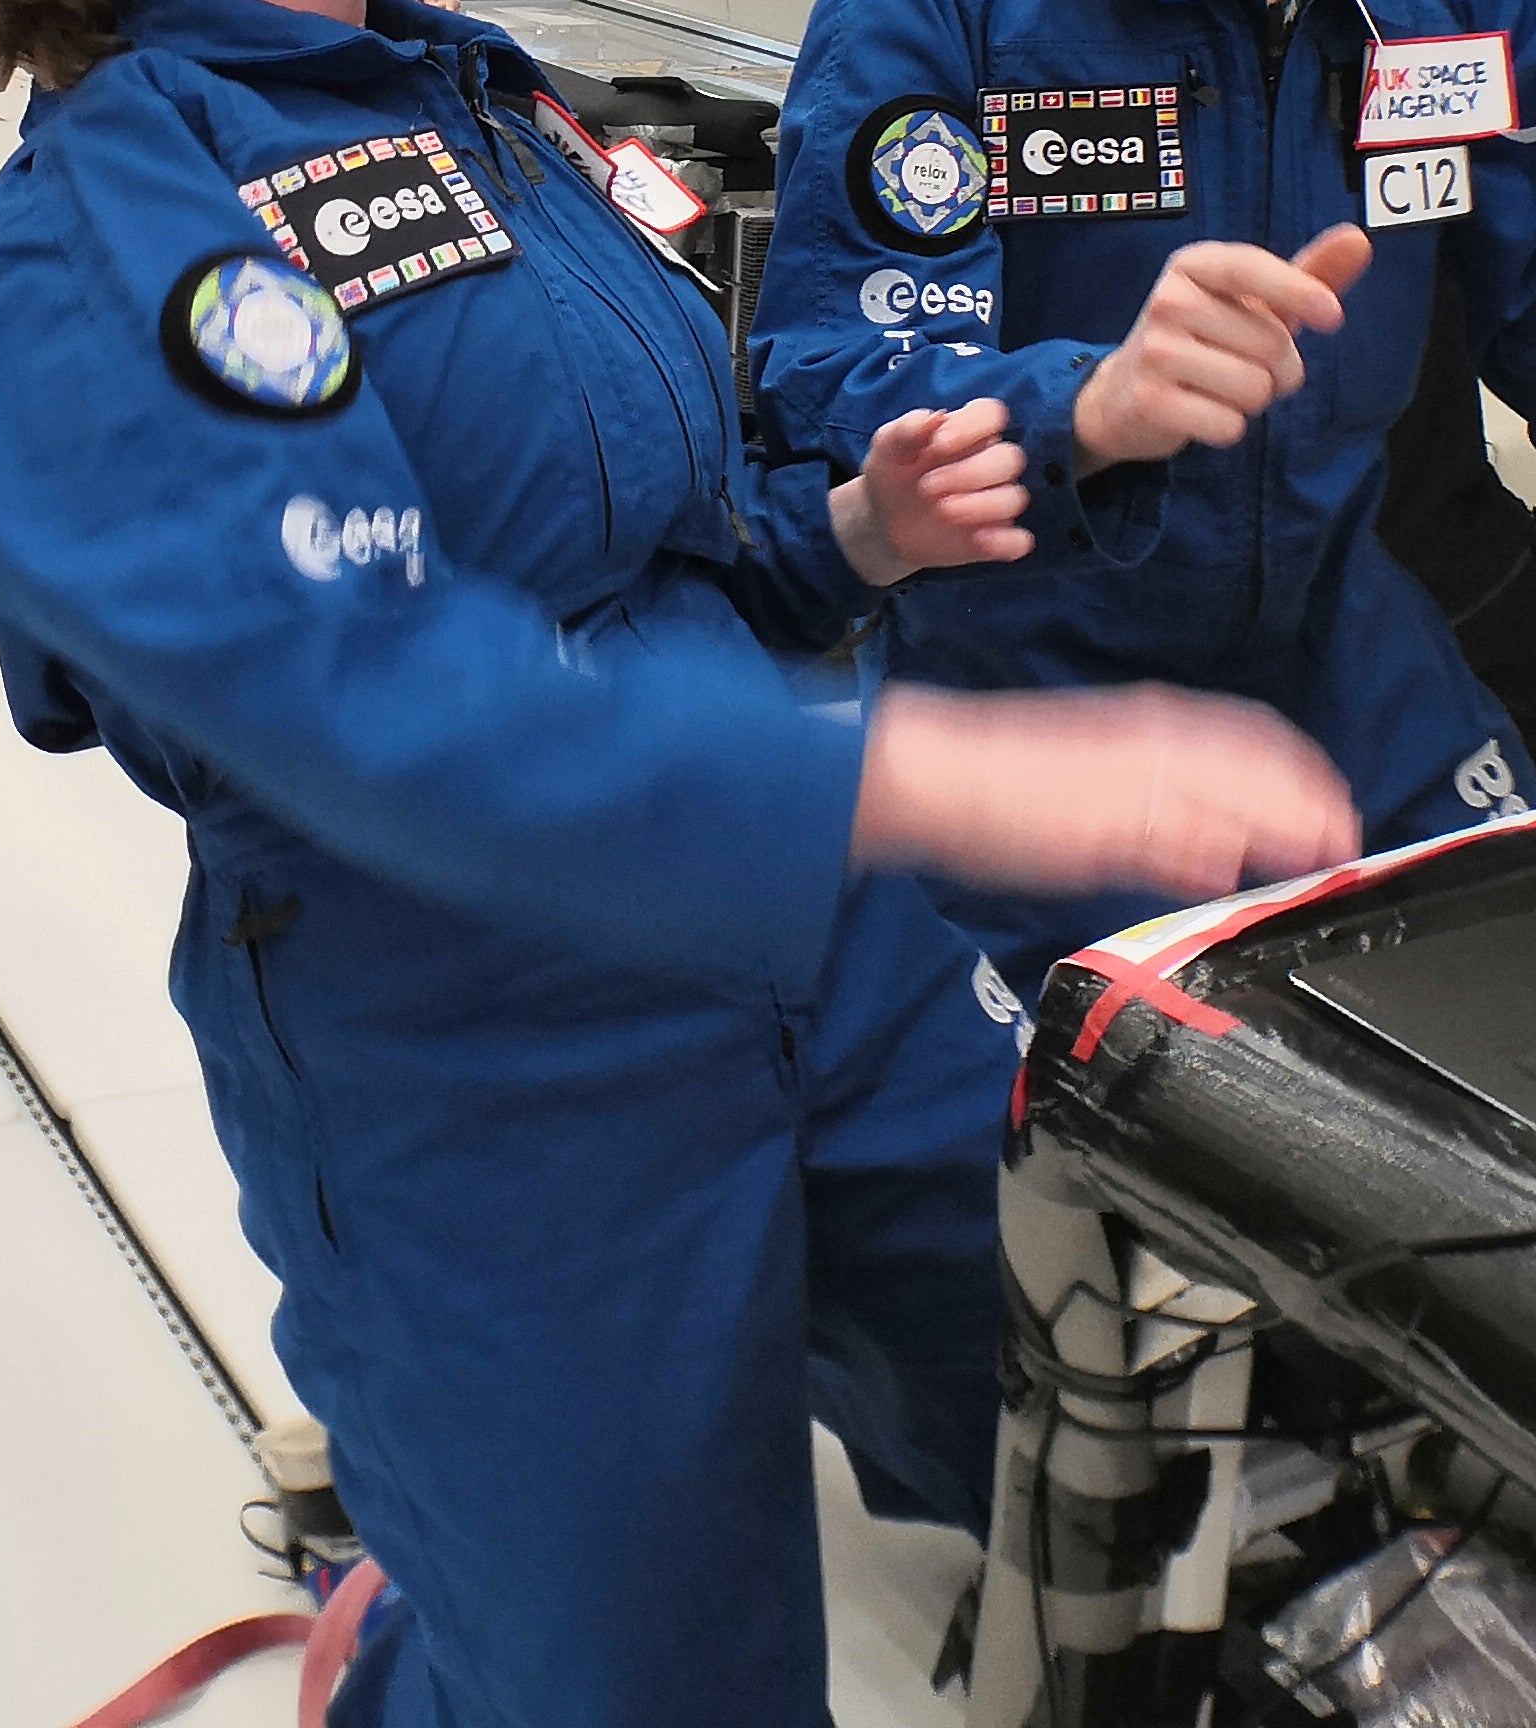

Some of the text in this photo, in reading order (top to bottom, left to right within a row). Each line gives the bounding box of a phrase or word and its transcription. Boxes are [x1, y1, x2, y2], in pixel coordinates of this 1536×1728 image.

[1383, 61, 1488, 91] UK SPACE
[1387, 89, 1479, 119] AGENCY
[1070, 136, 1145, 166] esa
[1379, 158, 1459, 215] C12
[369, 184, 447, 229] esa
[920, 282, 995, 325] esa
